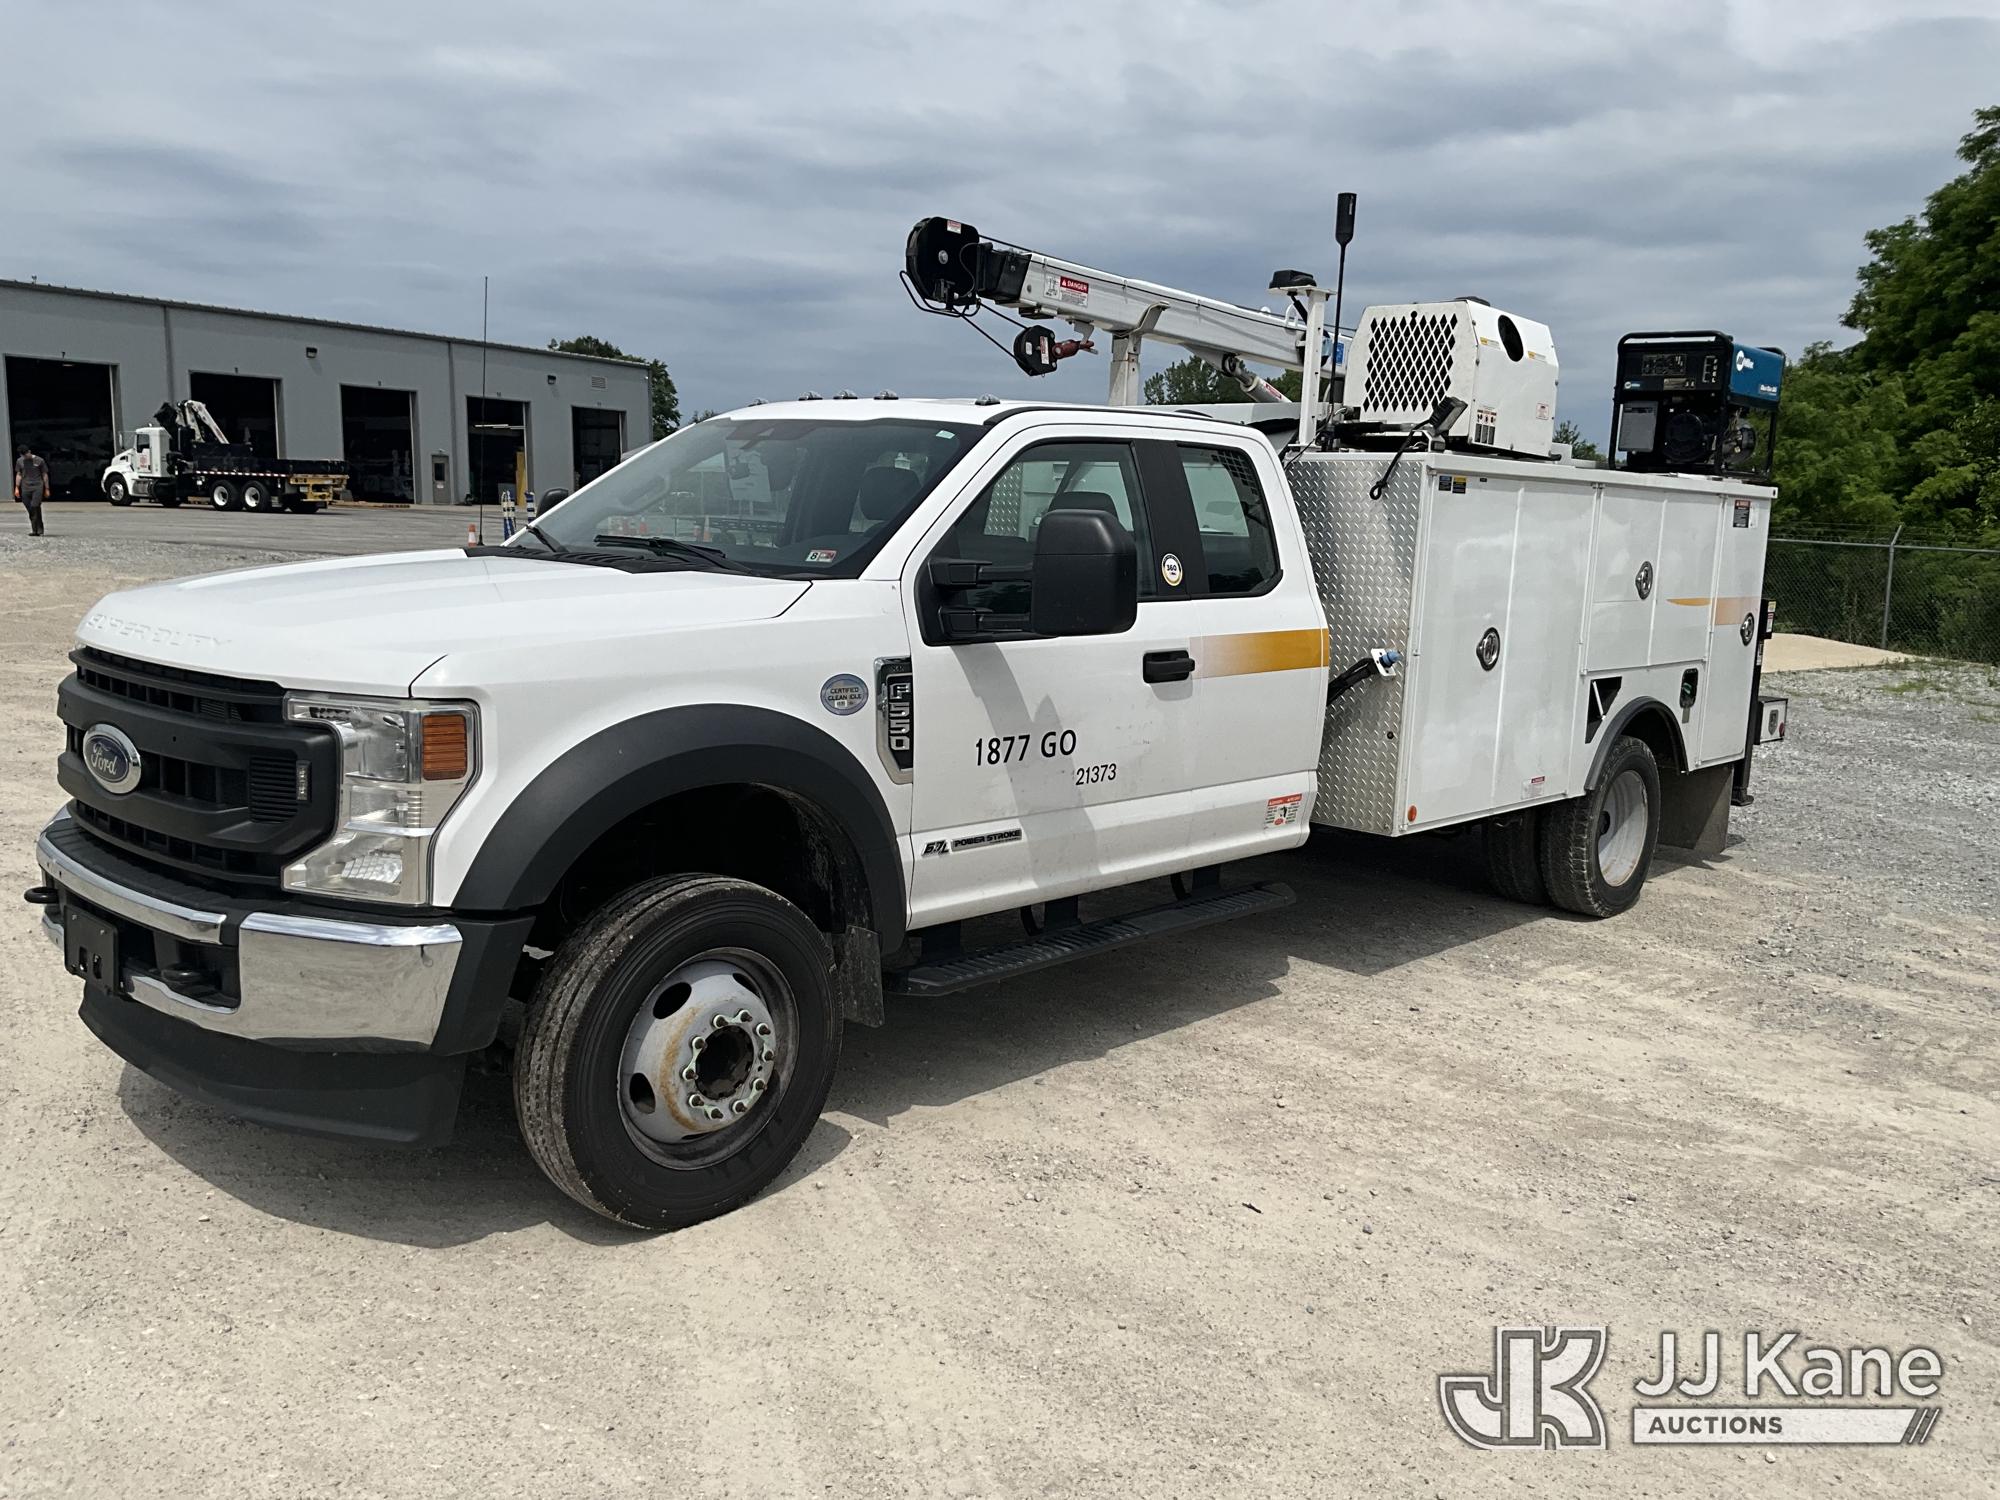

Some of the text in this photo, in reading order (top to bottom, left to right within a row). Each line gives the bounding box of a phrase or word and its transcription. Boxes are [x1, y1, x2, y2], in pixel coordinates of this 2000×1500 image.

[91, 742, 118, 776] Ford
[975, 729, 1077, 766] 1877 GO
[1075, 763, 1117, 786] 21373
[954, 836, 985, 848] POWER
[986, 829, 1022, 842] STROKE
